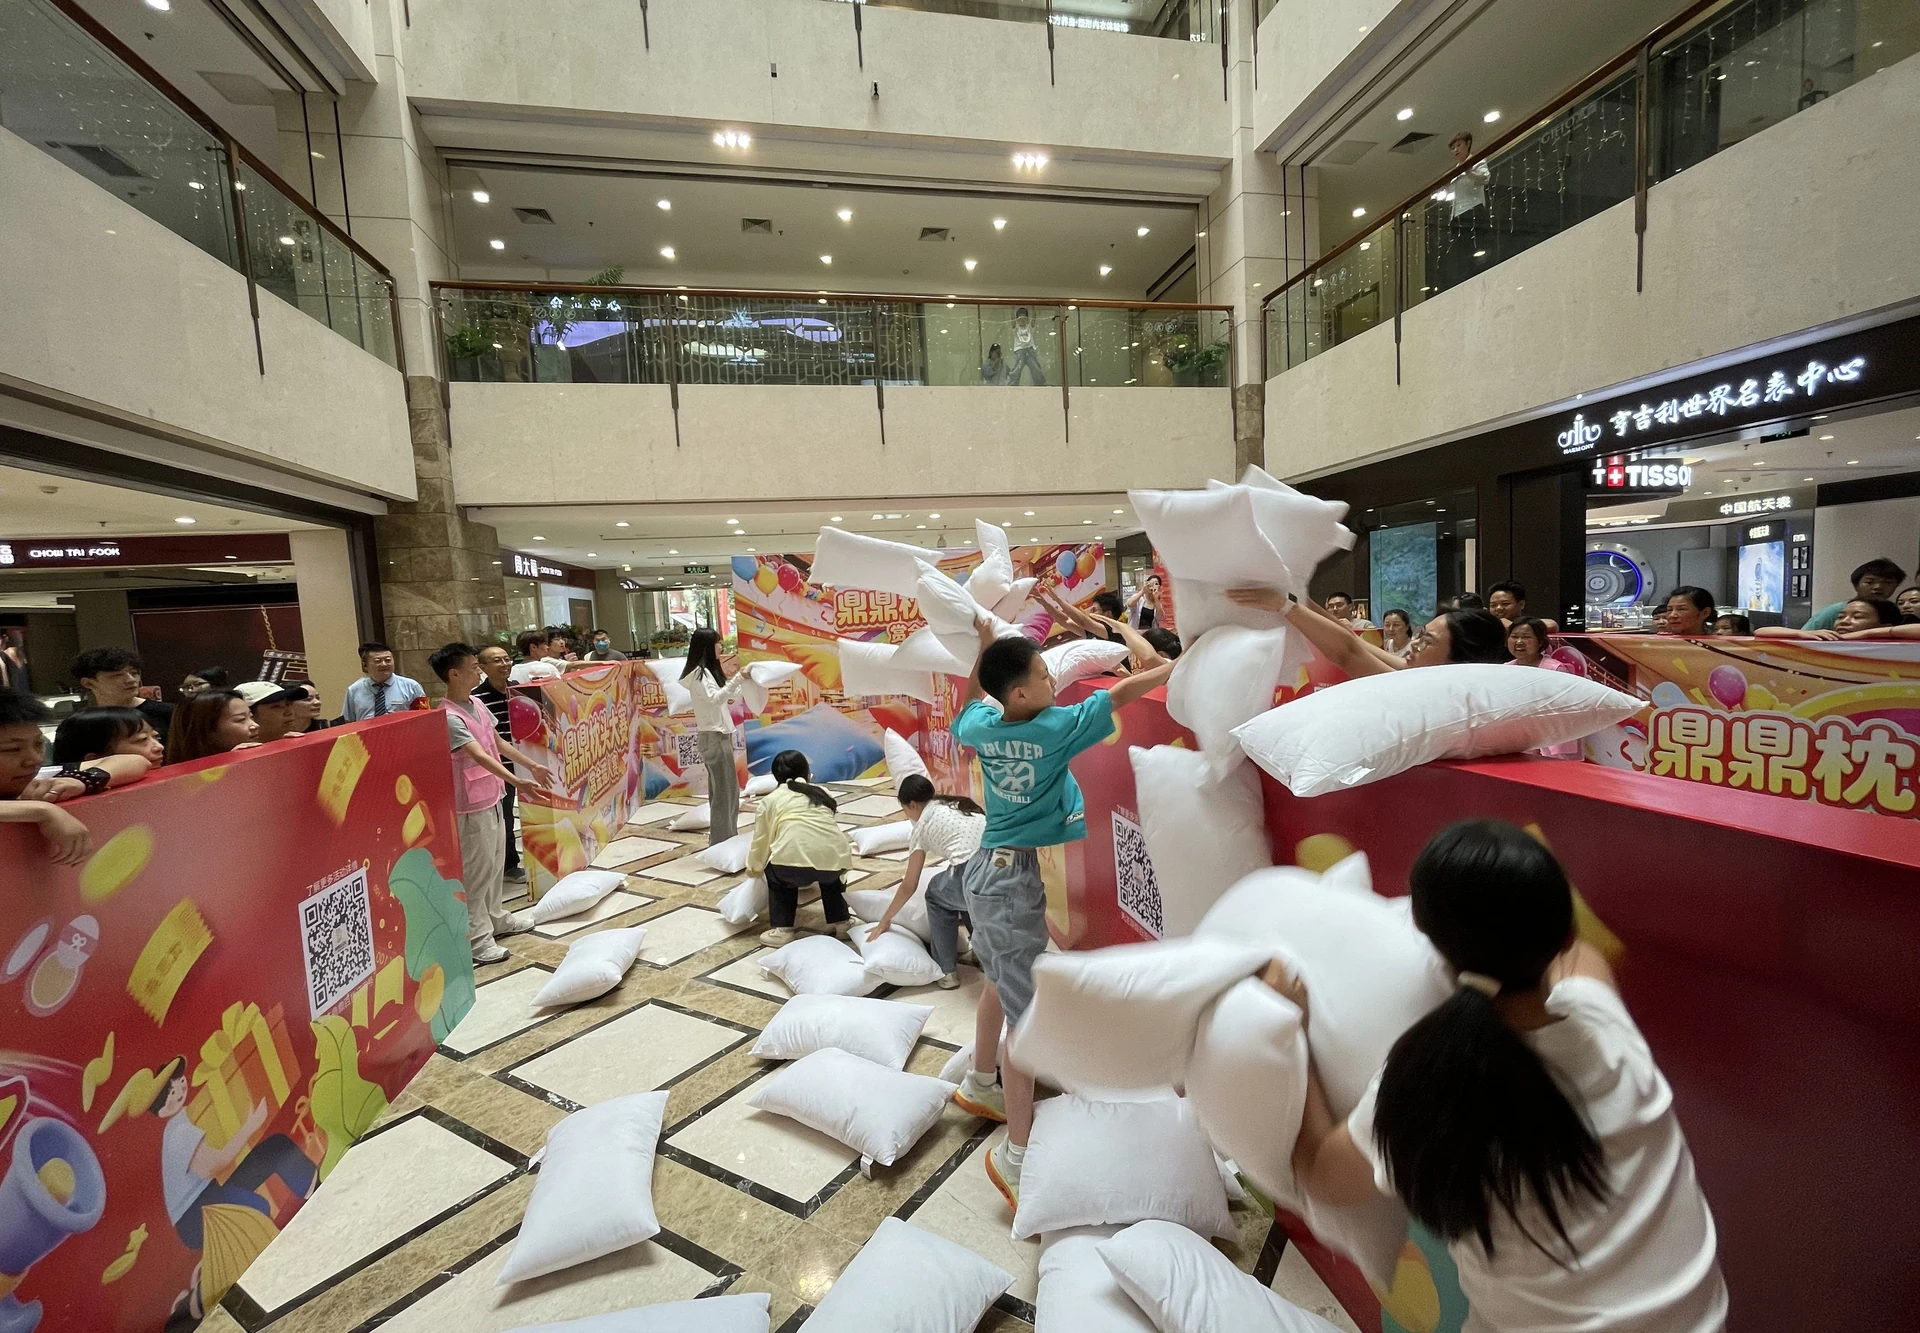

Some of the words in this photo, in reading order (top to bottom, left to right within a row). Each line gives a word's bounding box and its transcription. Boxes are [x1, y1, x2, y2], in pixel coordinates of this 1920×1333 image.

[1609, 357, 1865, 437] 亨吉利世界名表中心
[1720, 496, 1791, 515] 中国航天表
[29, 549, 64, 558] CHOW
[88, 547, 120, 557] FOOK
[563, 704, 629, 784] 鼎鼎枕头大赛
